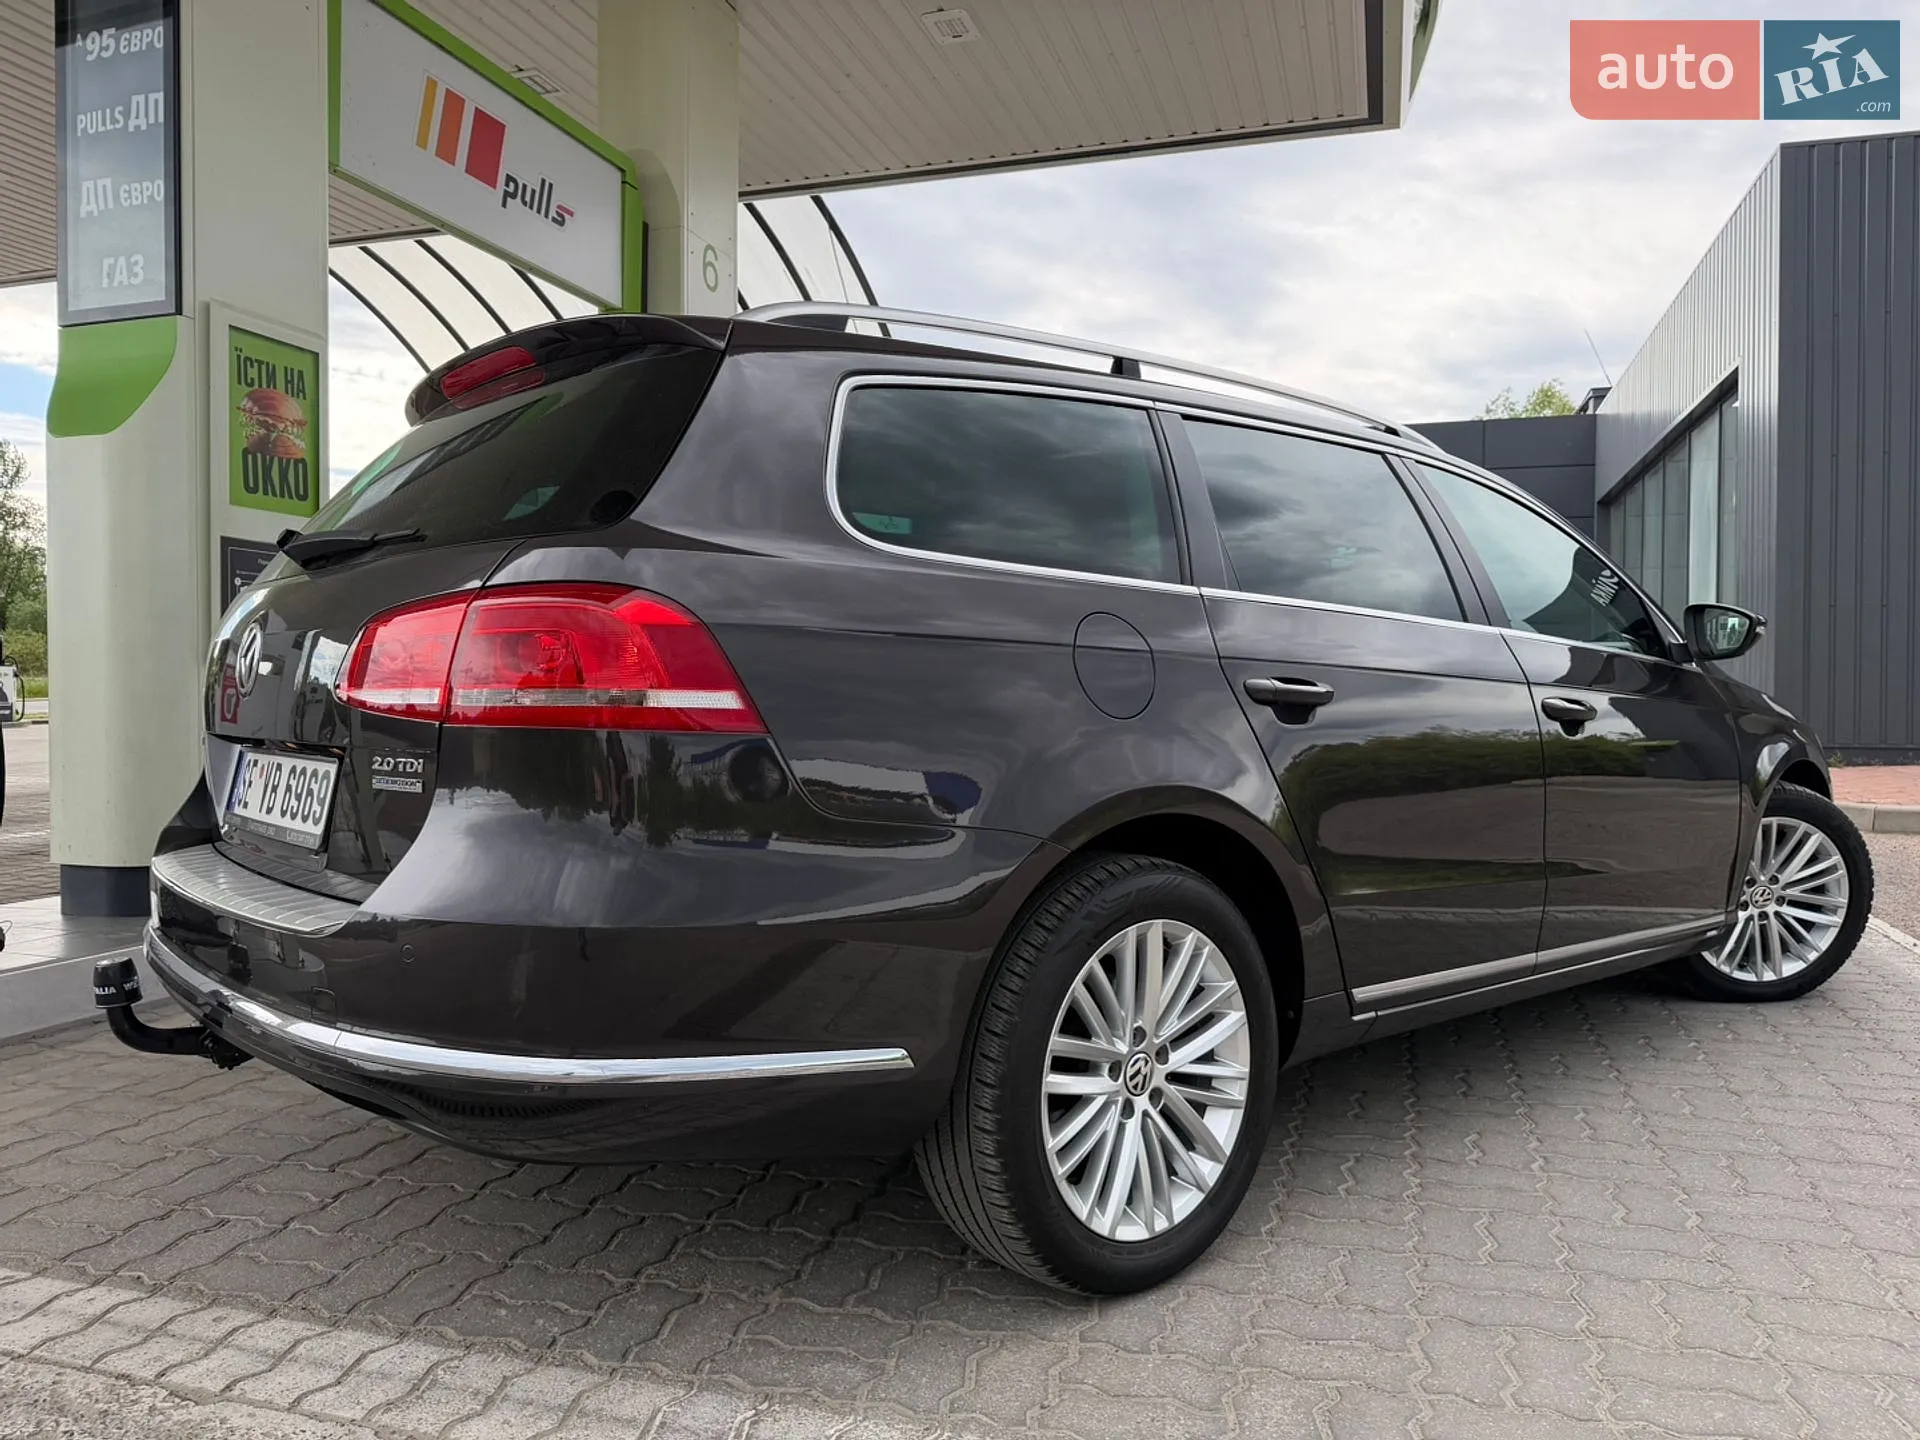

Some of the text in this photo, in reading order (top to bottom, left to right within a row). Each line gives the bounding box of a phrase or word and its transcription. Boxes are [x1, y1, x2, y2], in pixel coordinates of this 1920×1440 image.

[76, 92, 164, 136] PULLS ДП
[80, 178, 114, 218] ДП
[501, 172, 574, 228] pulls
[101, 253, 144, 288] ГАЗ
[702, 243, 718, 293] 6
[234, 346, 307, 401] ЇСТИ НА
[241, 446, 309, 502] ОККО
[395, 758, 424, 773] TDI
[280, 764, 331, 827] 6969
